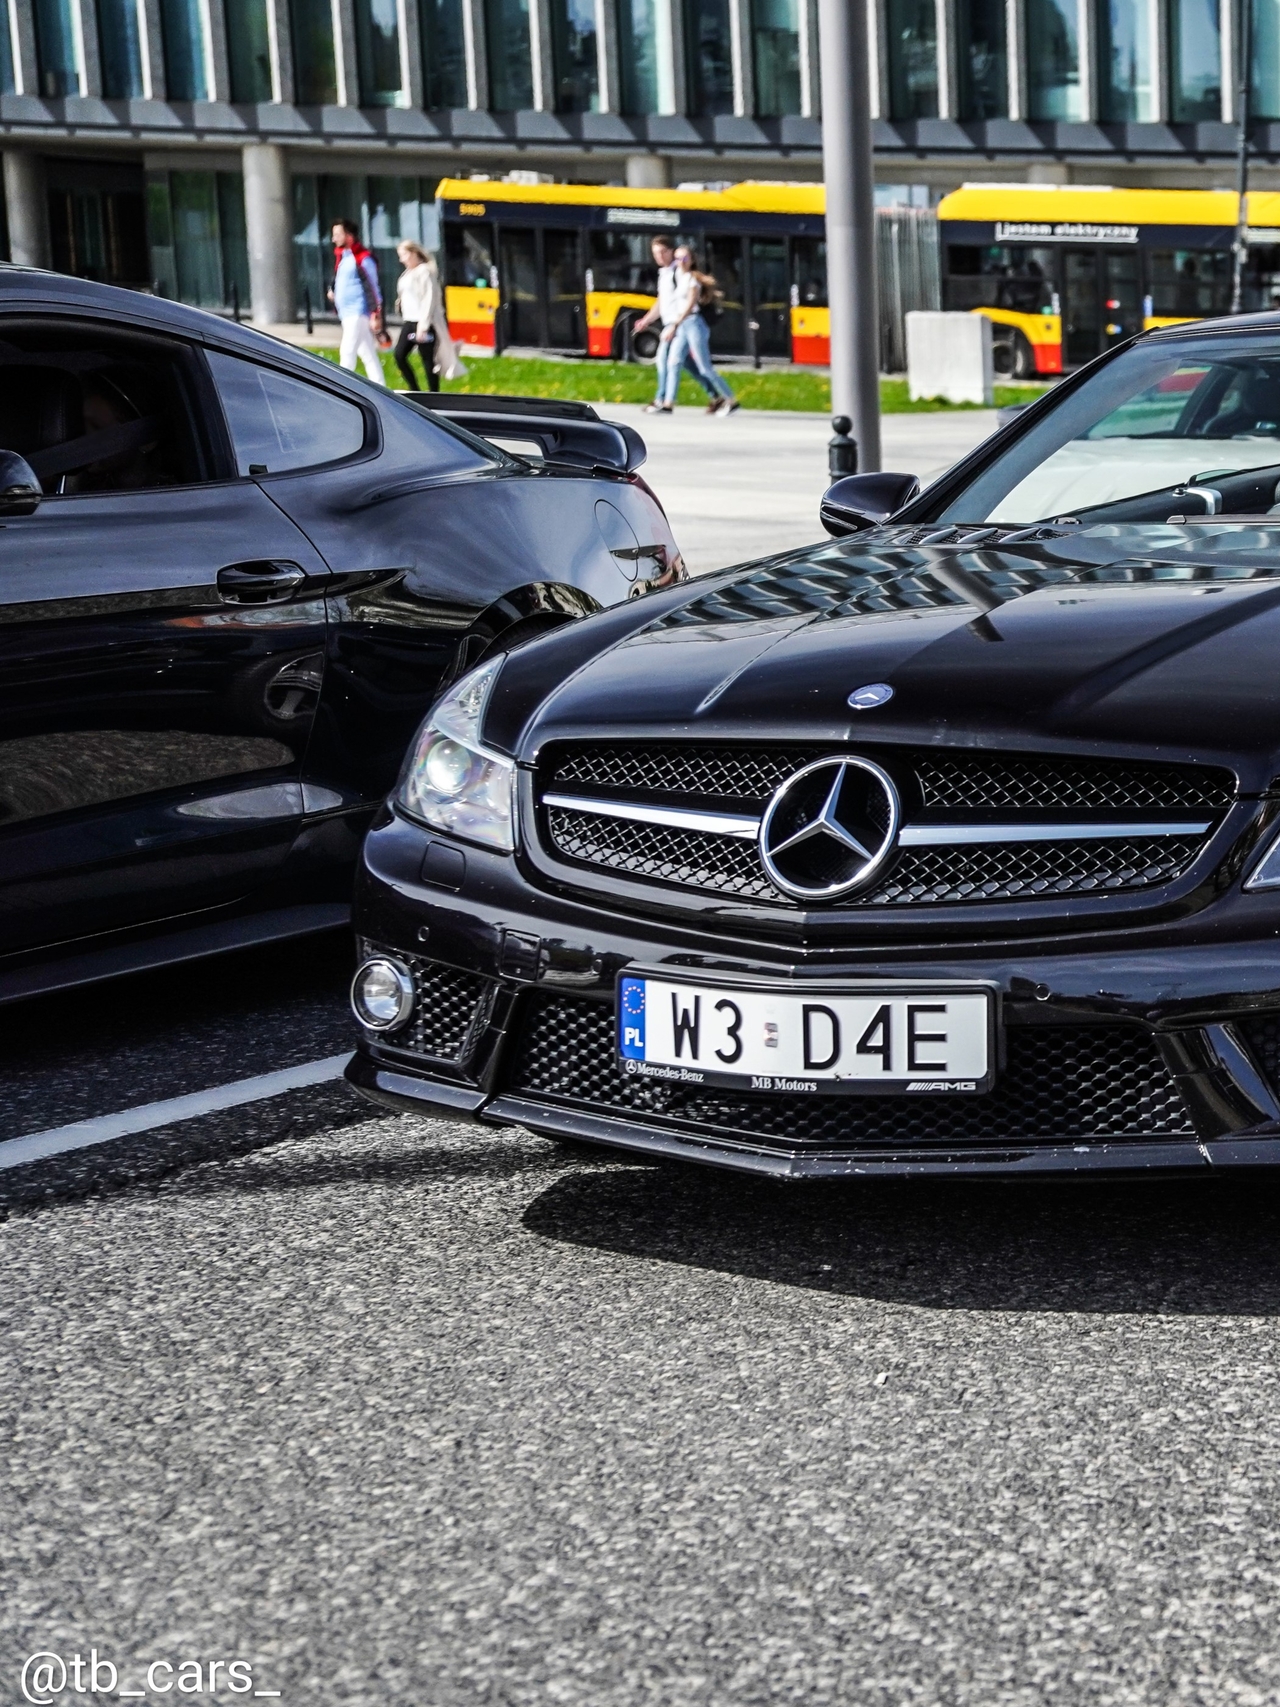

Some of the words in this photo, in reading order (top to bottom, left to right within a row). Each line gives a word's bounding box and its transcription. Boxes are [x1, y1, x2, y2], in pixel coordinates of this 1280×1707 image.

[1053, 222, 1139, 240] elektryczny
[624, 1027, 644, 1047] PL
[671, 992, 743, 1065] W3
[803, 1003, 948, 1073] D4E
[637, 1062, 704, 1082] Mercedes-Benz
[751, 1076, 773, 1089] MB
[773, 1077, 817, 1092] Motors
[930, 1081, 976, 1091] AMG
